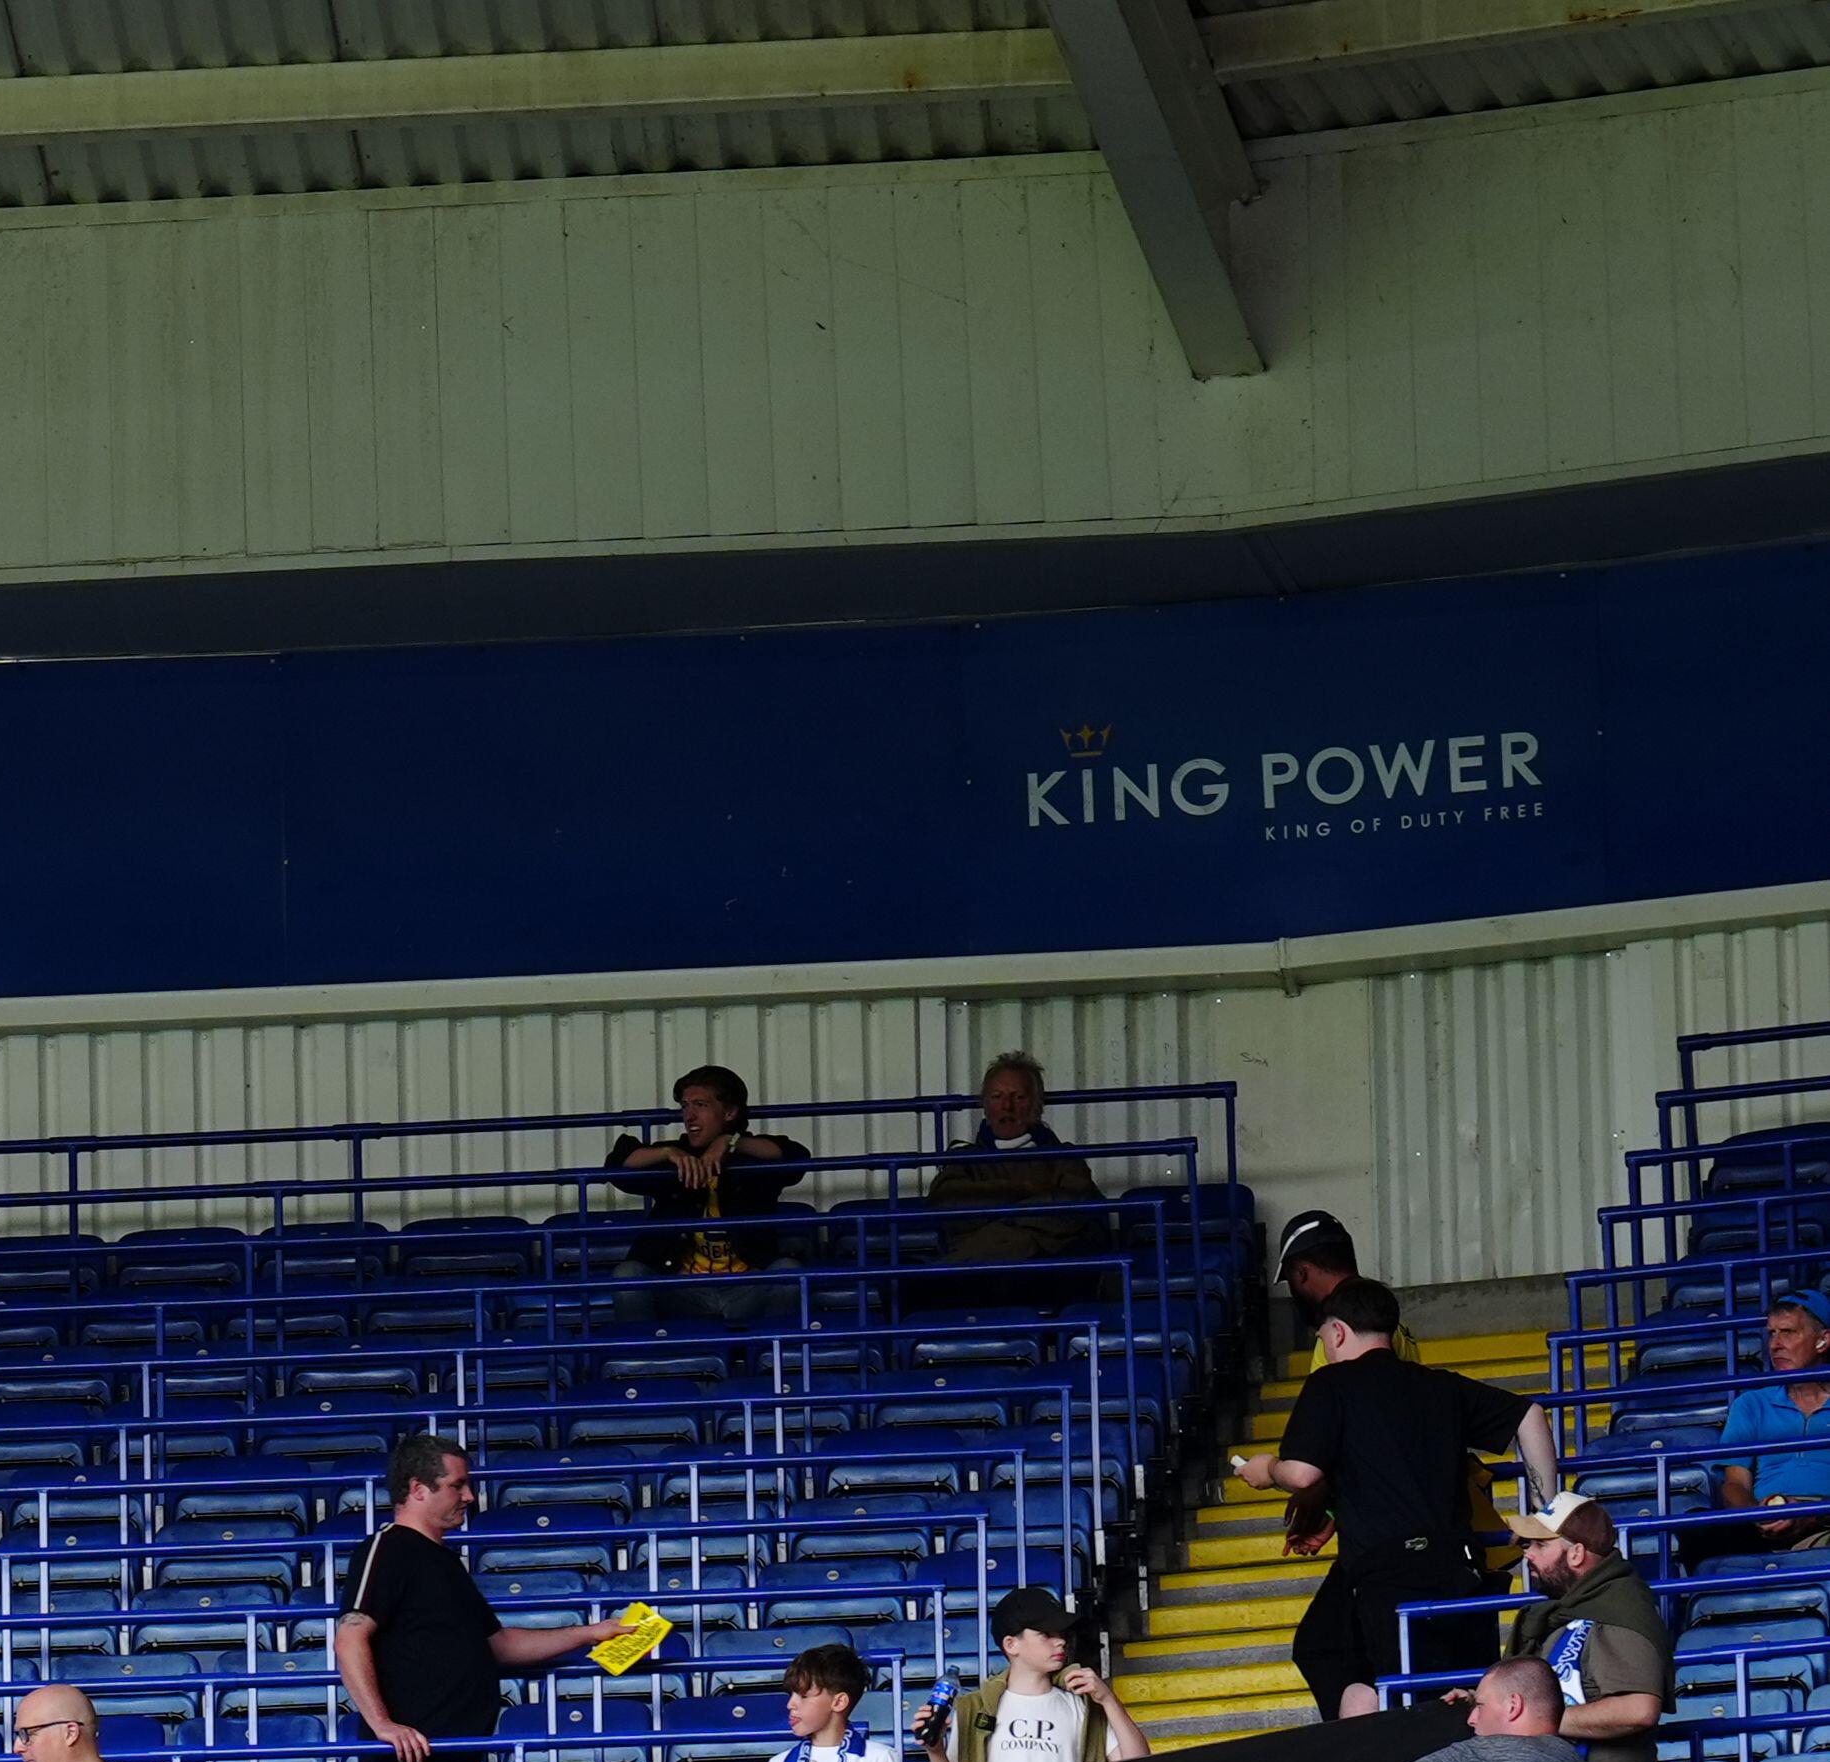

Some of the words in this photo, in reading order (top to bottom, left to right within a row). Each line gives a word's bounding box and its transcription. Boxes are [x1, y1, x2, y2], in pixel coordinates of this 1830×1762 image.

[1027, 758, 1229, 827] KING
[1261, 732, 1542, 808] POWER
[1265, 822, 1332, 841] KING
[1350, 817, 1382, 834] OF
[1400, 810, 1464, 829] DUTY
[1484, 802, 1543, 821] FREE
[1008, 1718, 1055, 1741] C.P.
[1000, 1739, 1060, 1754] COMPANY
